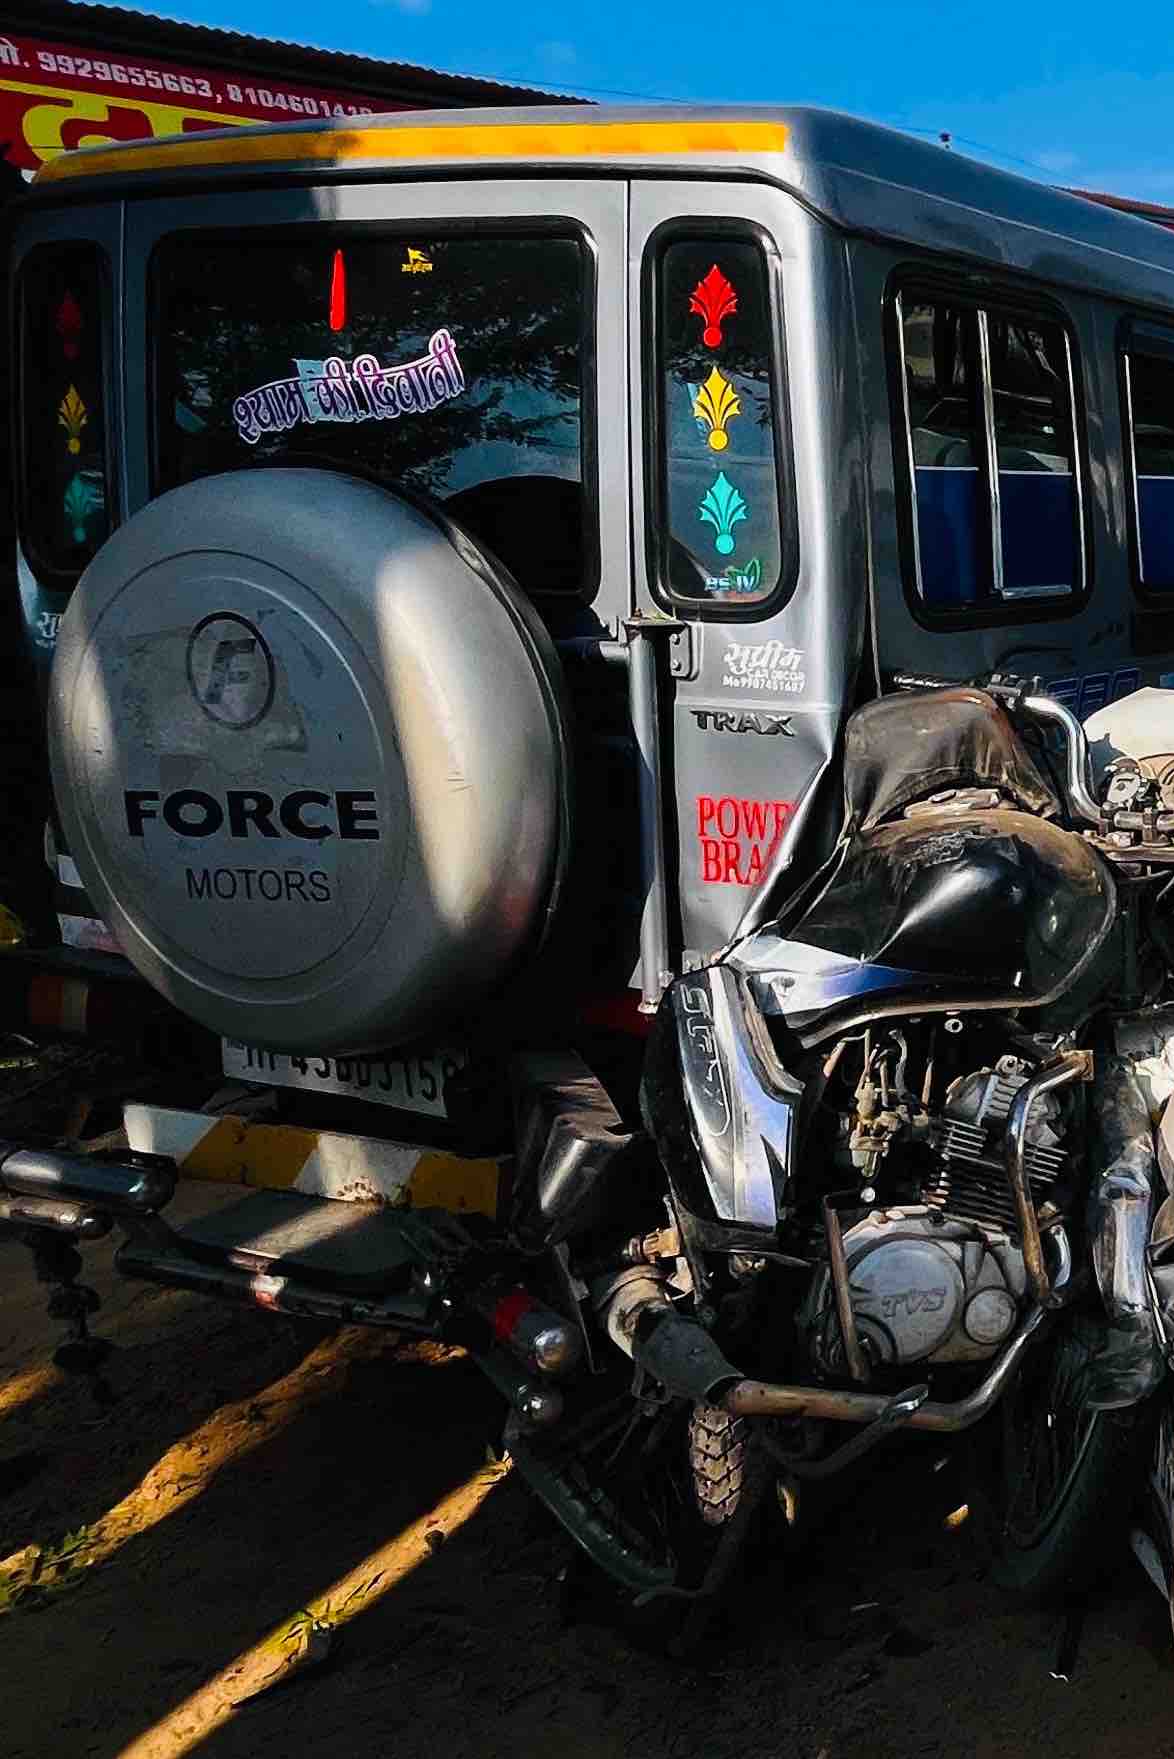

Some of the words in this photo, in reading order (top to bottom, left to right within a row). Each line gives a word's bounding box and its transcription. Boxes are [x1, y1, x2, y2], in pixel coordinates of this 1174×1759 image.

[690, 710, 796, 737] TRAX
[124, 790, 380, 841] FORCE
[696, 794, 794, 841] POWE
[186, 868, 331, 902] MOTORS
